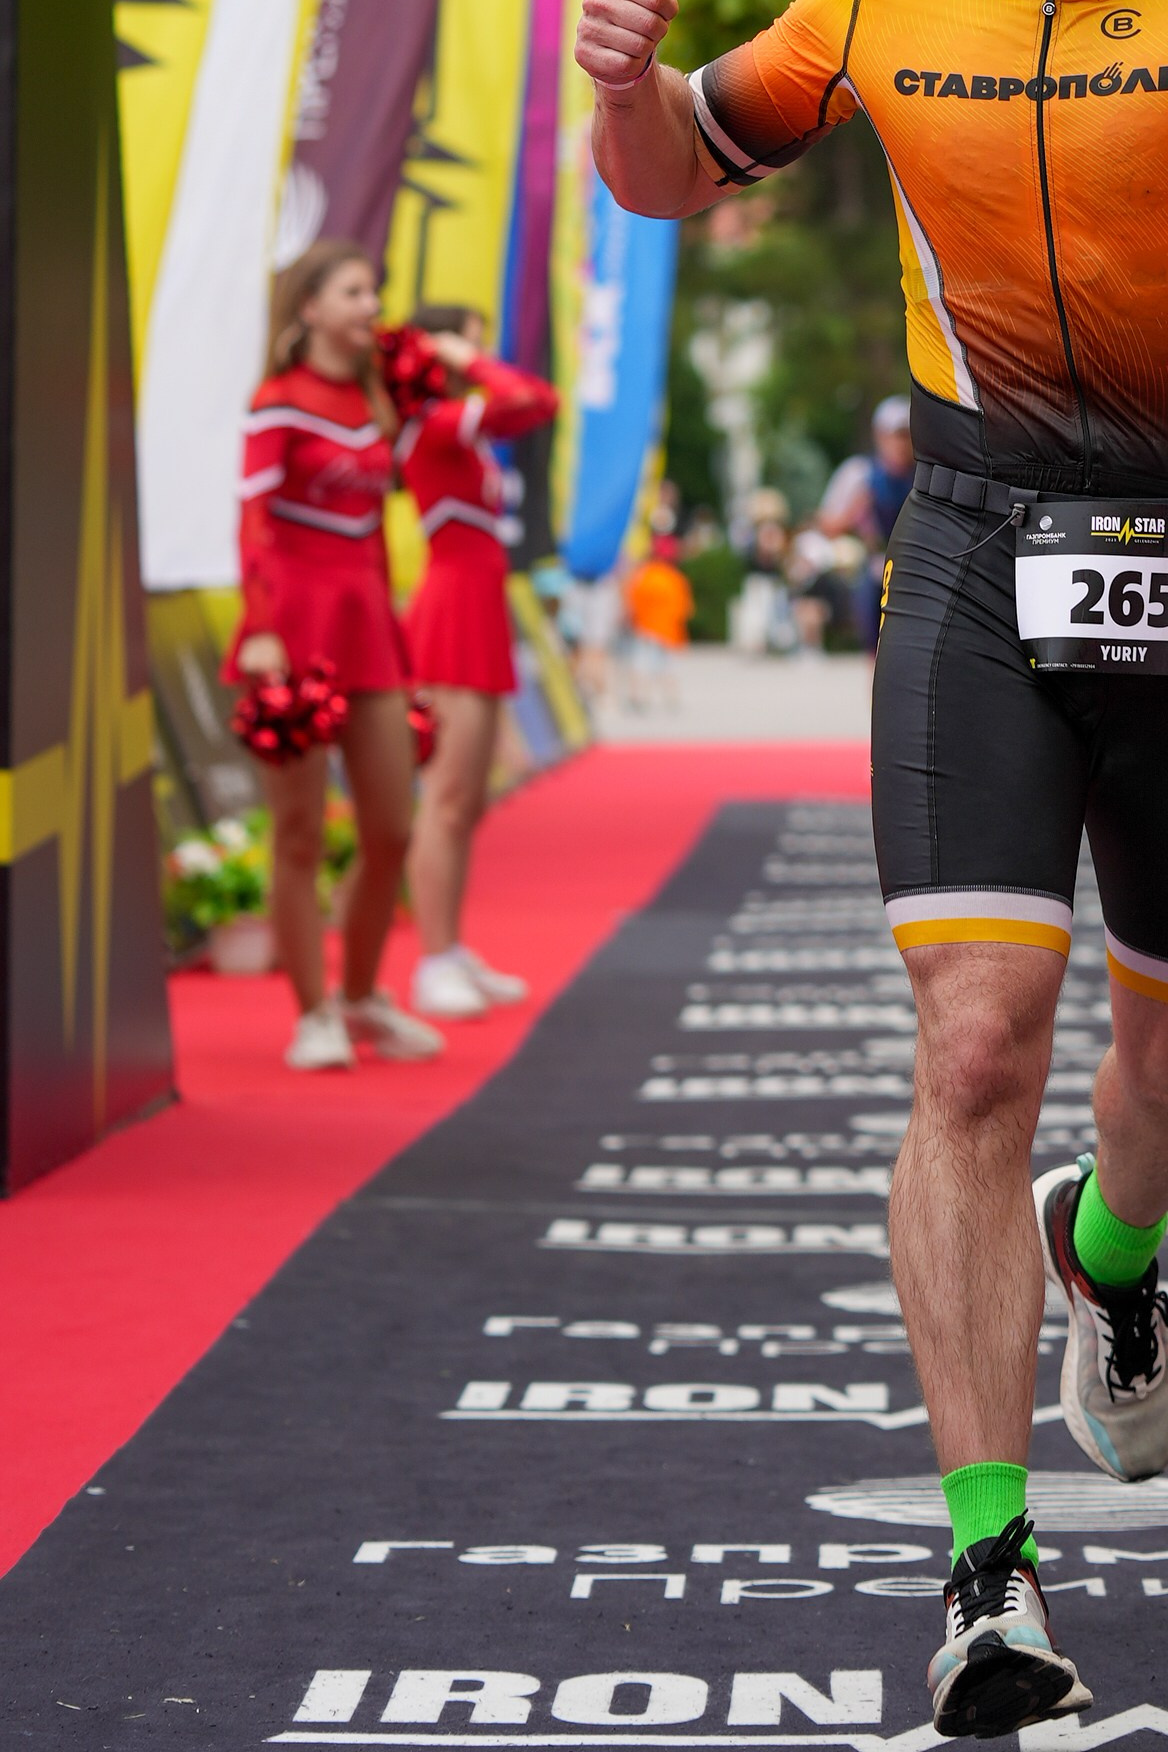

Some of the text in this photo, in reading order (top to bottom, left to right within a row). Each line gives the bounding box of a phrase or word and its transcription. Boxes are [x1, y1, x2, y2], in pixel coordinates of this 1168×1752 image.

[1091, 516, 1165, 534] IRON STAR
[1100, 645, 1148, 663] YURIY
[457, 1382, 889, 1411] IRON
[292, 1669, 883, 1725] IRON
